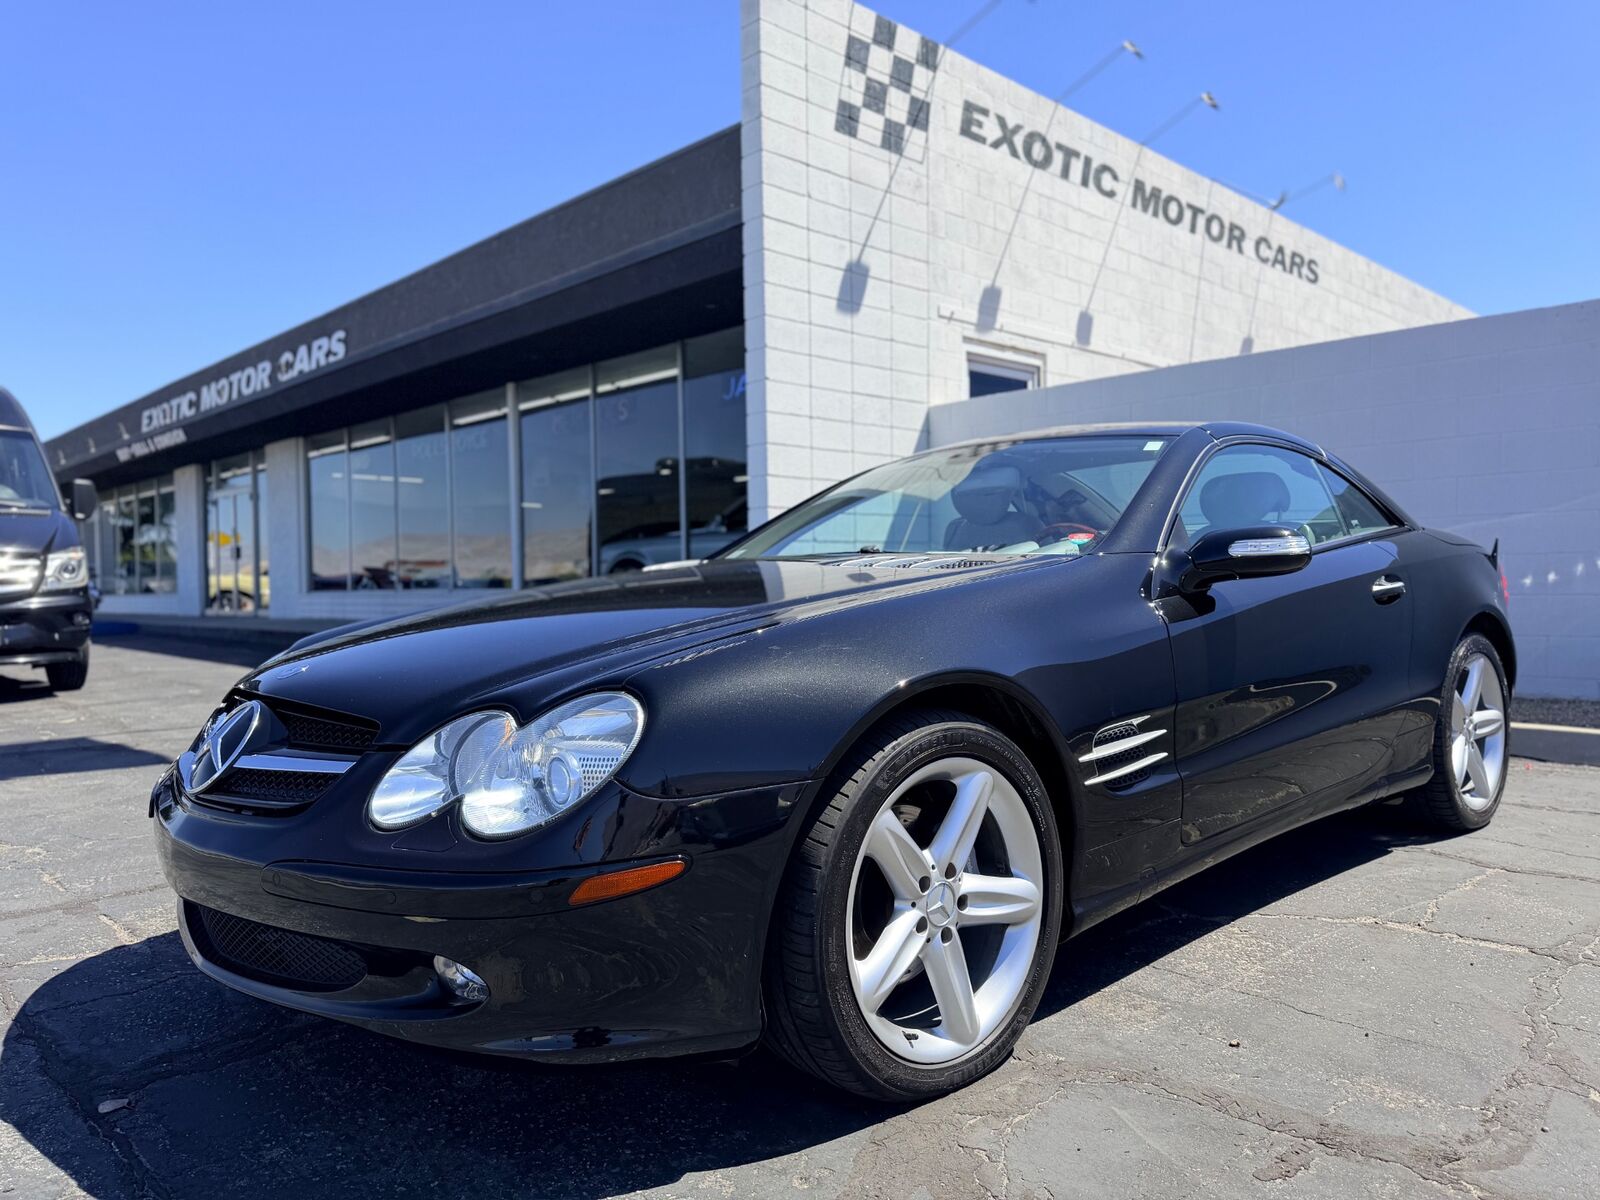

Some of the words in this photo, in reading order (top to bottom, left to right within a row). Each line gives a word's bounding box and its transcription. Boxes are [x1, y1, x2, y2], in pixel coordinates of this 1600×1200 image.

[959, 99, 1120, 200] EXOTIC
[1131, 178, 1247, 256] MOTOR
[1254, 235, 1321, 286] CARS
[141, 391, 198, 433] EXOTIC
[200, 360, 272, 412] MOTOR
[277, 329, 346, 382] CARS
